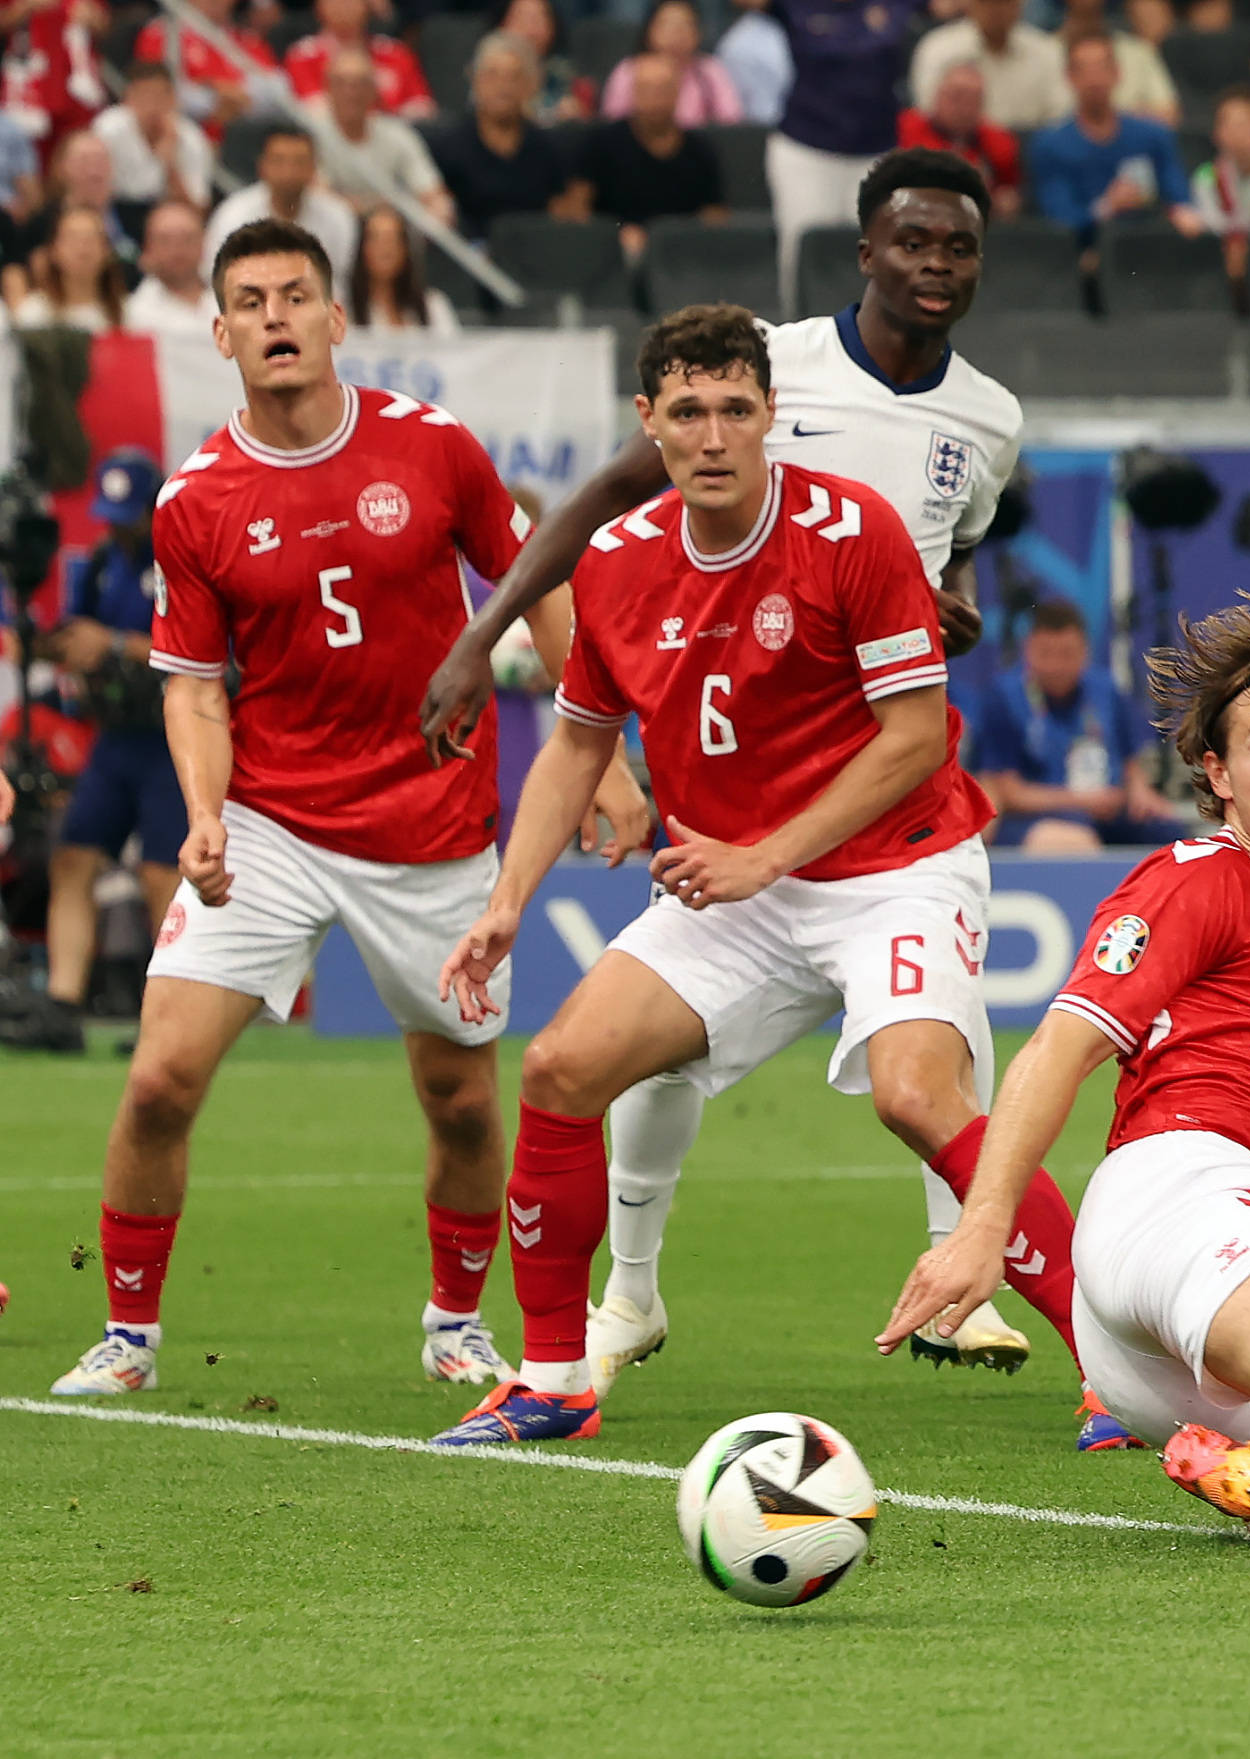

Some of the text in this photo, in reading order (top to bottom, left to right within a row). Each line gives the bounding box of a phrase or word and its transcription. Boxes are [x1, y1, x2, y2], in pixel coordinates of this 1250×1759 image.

[318, 564, 364, 649] 5
[699, 673, 739, 757] 6
[889, 934, 925, 998] 6
